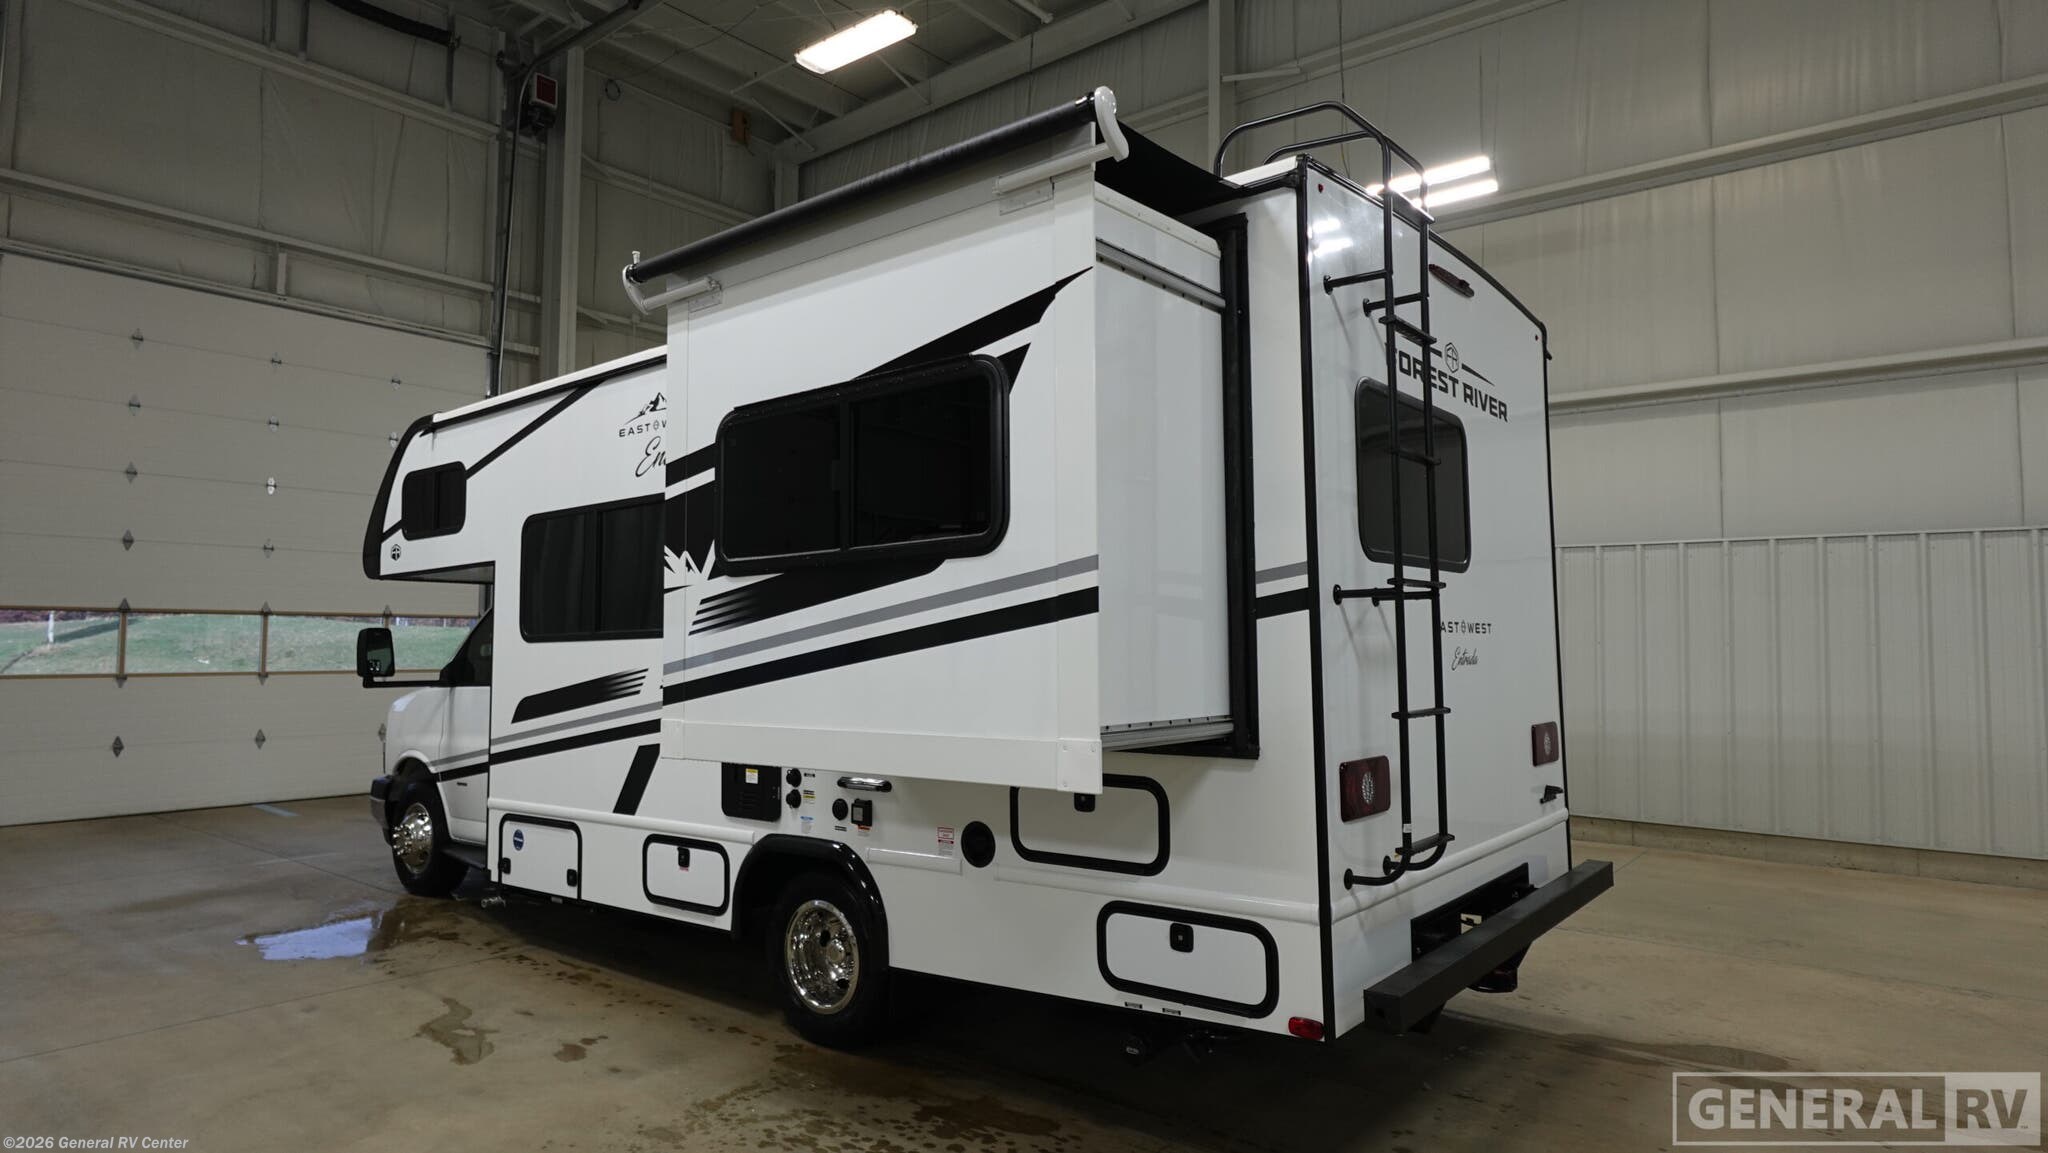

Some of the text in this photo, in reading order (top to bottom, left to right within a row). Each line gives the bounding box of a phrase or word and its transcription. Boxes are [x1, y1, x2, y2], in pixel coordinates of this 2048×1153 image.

[1395, 349, 1508, 422] OREST RIVER
[619, 423, 650, 437] EAST
[1440, 621, 1492, 635] AST WEST
